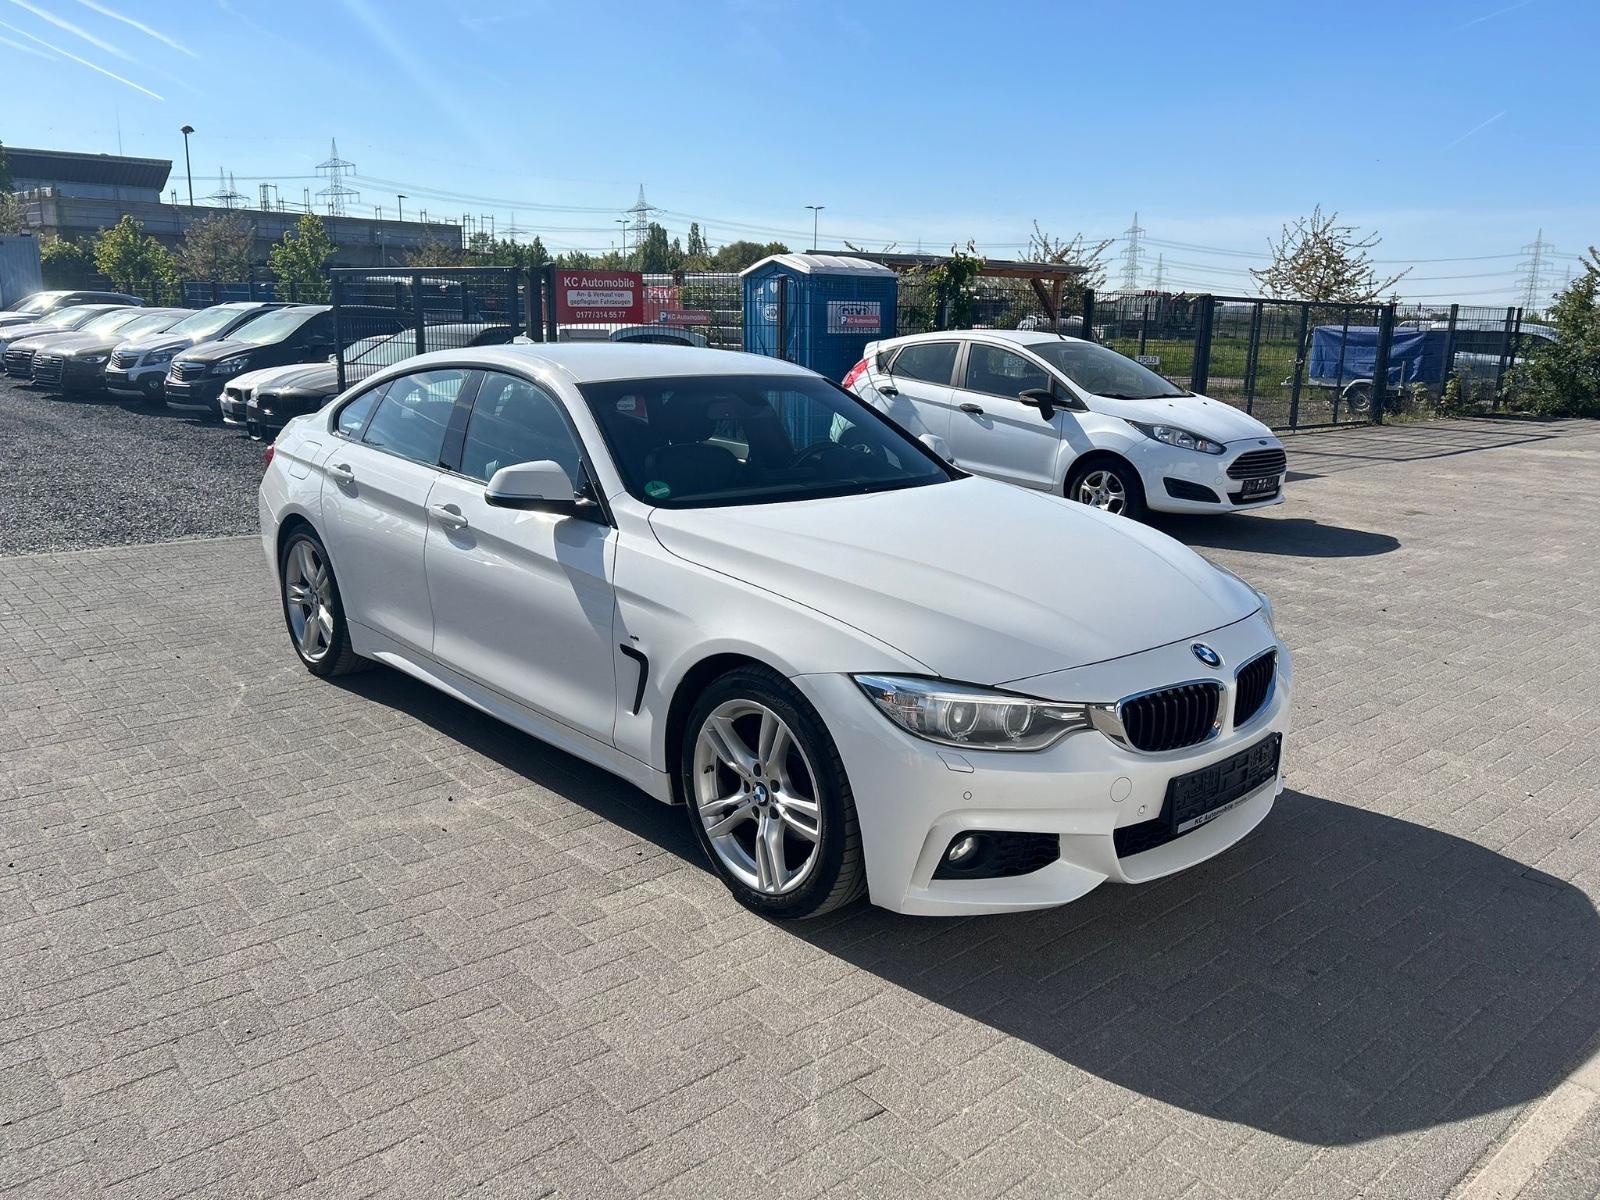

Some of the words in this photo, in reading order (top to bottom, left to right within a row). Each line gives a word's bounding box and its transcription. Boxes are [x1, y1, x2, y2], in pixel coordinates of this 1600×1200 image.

[563, 277, 579, 287] KC
[581, 277, 635, 288] Automobile
[600, 298, 632, 306] Fahrzeugen
[1194, 816, 1204, 825] KC
